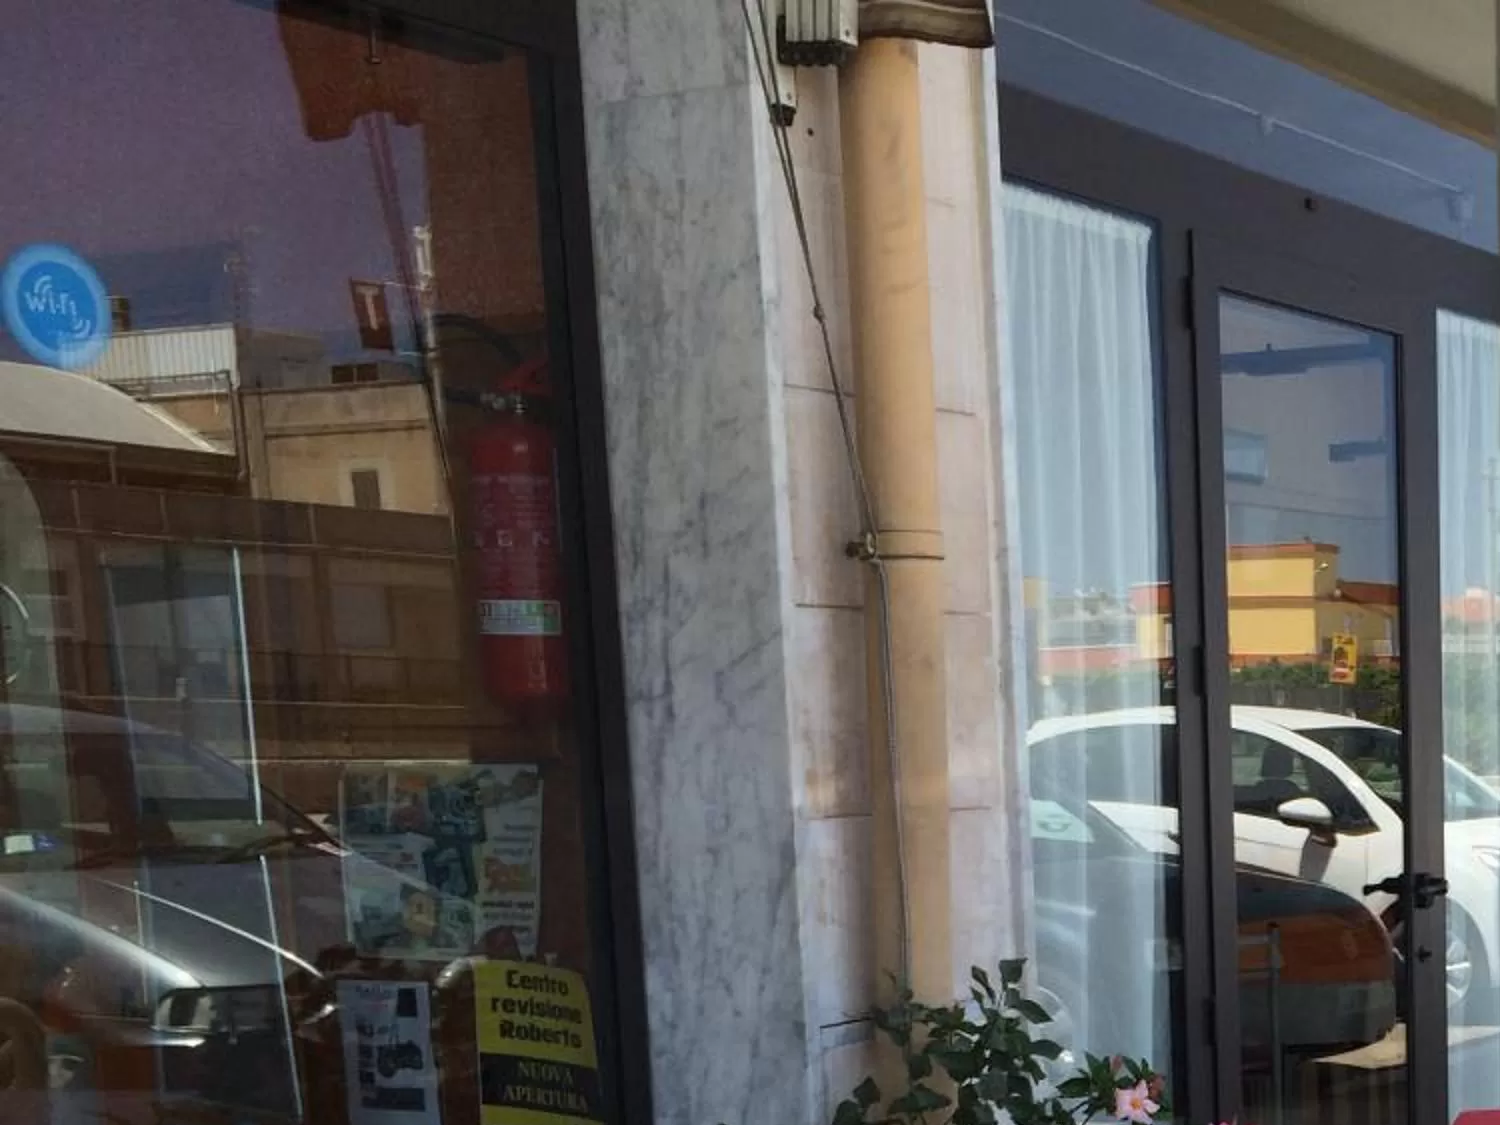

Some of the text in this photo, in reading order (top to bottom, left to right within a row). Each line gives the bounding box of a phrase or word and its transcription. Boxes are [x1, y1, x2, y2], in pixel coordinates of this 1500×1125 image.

[506, 969, 569, 996] Centro
[491, 996, 583, 1024] revisione
[499, 1020, 583, 1048] Roberto
[517, 1061, 574, 1086] NUOVA
[503, 1084, 589, 1113] APERTURA
